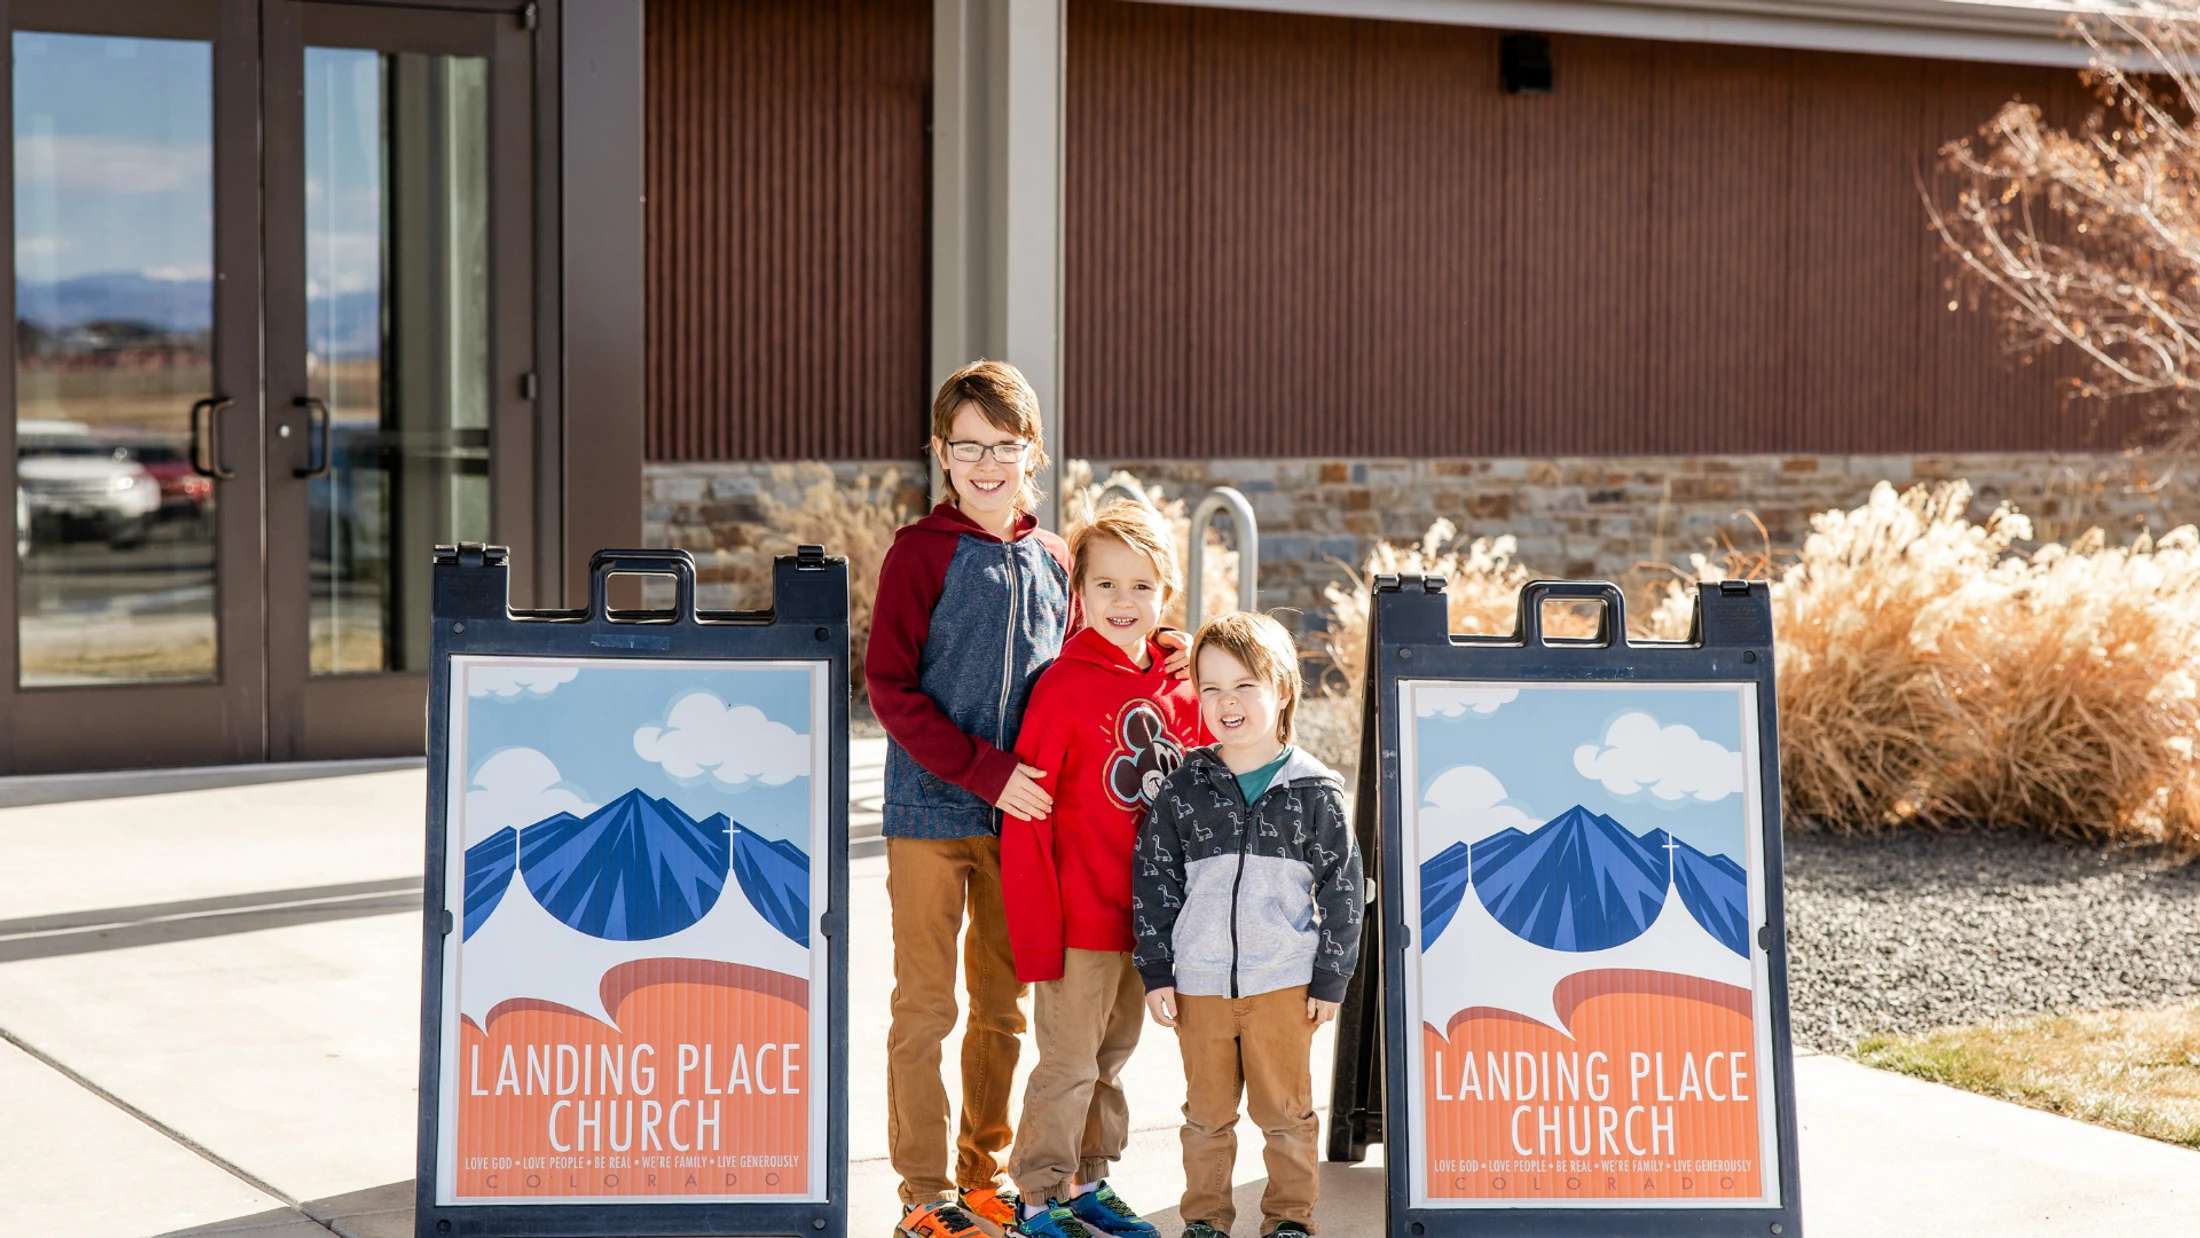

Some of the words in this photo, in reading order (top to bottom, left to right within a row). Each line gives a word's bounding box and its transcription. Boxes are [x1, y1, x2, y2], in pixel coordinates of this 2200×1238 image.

[470, 1043, 655, 1096] LANDING
[678, 1043, 801, 1095] PLACE
[1434, 1051, 1609, 1102] LANDING
[1631, 1051, 1749, 1101] PLACE
[548, 1100, 720, 1152] CHURCH
[1511, 1105, 1675, 1156] CHURCH
[464, 1157, 489, 1170] LOVE
[491, 1157, 513, 1169] GOD
[523, 1157, 546, 1169] LOVE
[550, 1156, 585, 1169] PEOPLE
[594, 1156, 606, 1169] BE
[609, 1156, 632, 1168] REAL
[642, 1156, 671, 1168] WE'RE
[674, 1156, 708, 1168] FAMILY
[717, 1155, 737, 1168] LIVE
[740, 1155, 800, 1168] GENEROUSLY
[1433, 1160, 1456, 1172] LOVE
[1459, 1160, 1479, 1172] GOD
[1488, 1160, 1511, 1172] LOVE
[1514, 1160, 1547, 1172] PEOPLE
[1555, 1160, 1568, 1172] BE
[1570, 1160, 1593, 1172] REAL
[1601, 1160, 1629, 1173] WE'RE
[1632, 1160, 1664, 1172] FAMILY
[1673, 1160, 1694, 1173] LIVE
[1695, 1160, 1752, 1172] GENEROUSLY
